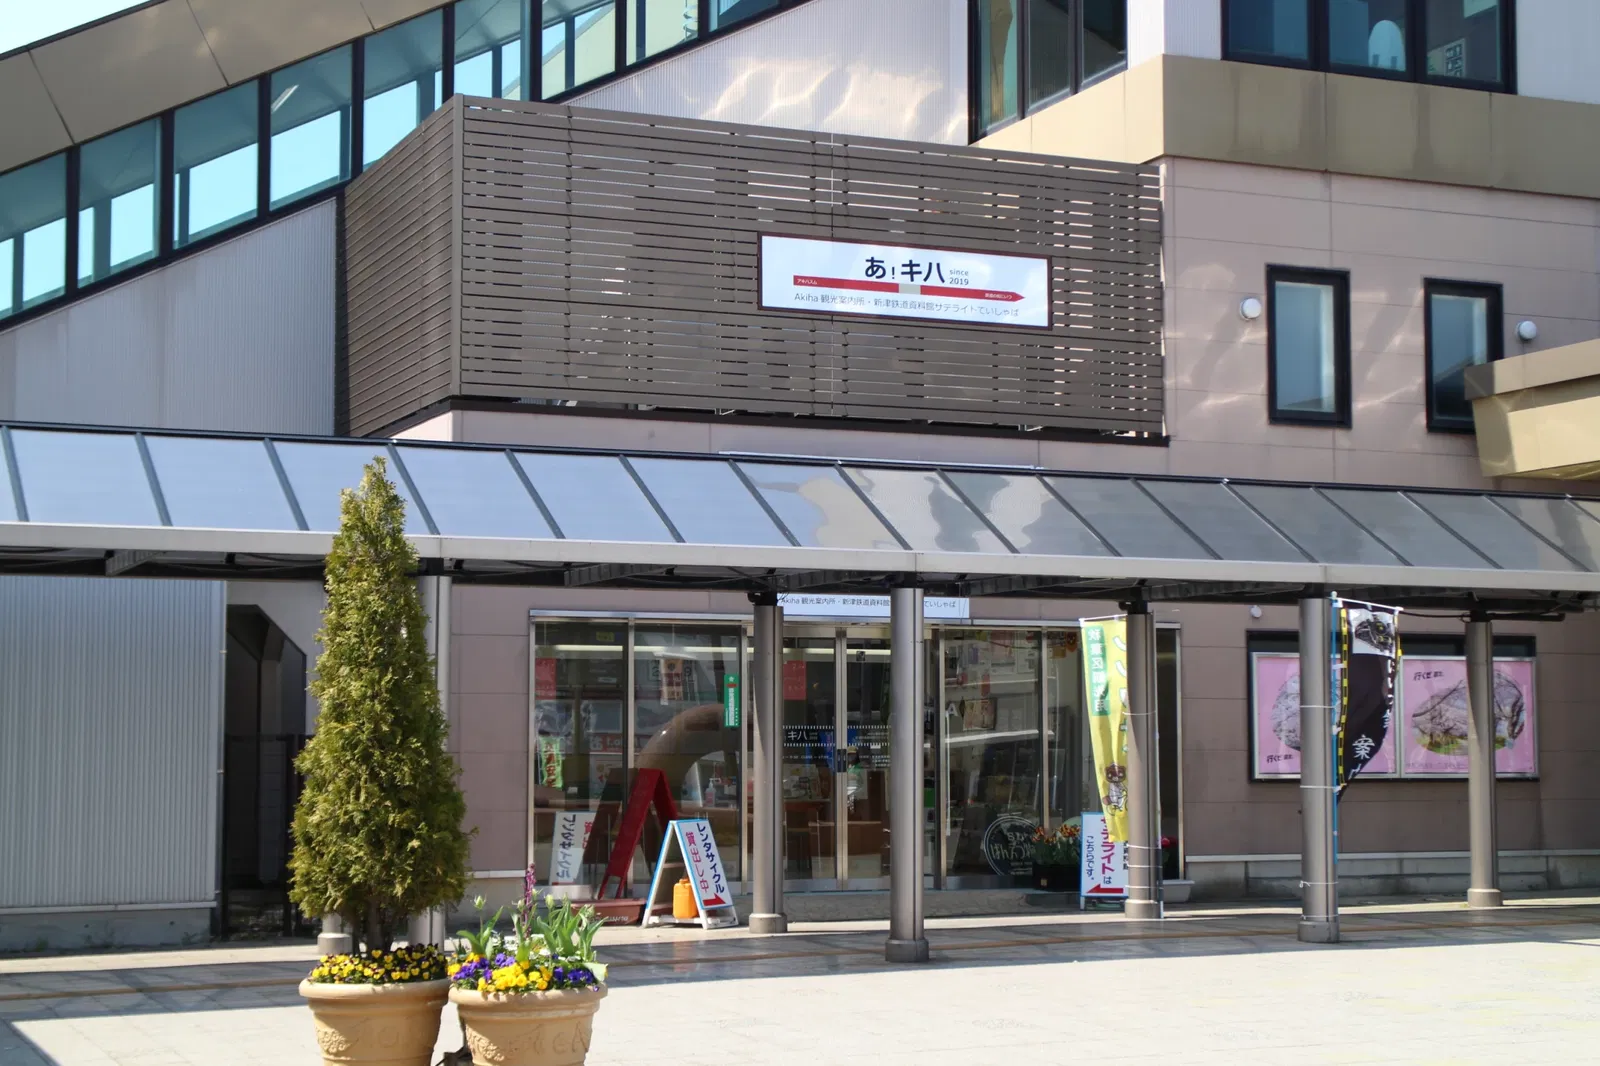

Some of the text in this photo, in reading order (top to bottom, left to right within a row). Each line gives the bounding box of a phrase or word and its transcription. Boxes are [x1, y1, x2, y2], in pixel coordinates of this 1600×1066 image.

[865, 256, 946, 284] あ!キハ
[949, 269, 969, 277] since
[949, 277, 970, 286] 2019
[794, 292, 819, 303] Akiha
[685, 831, 710, 893] 貸出し中
[696, 822, 726, 894] レンタサイクル
